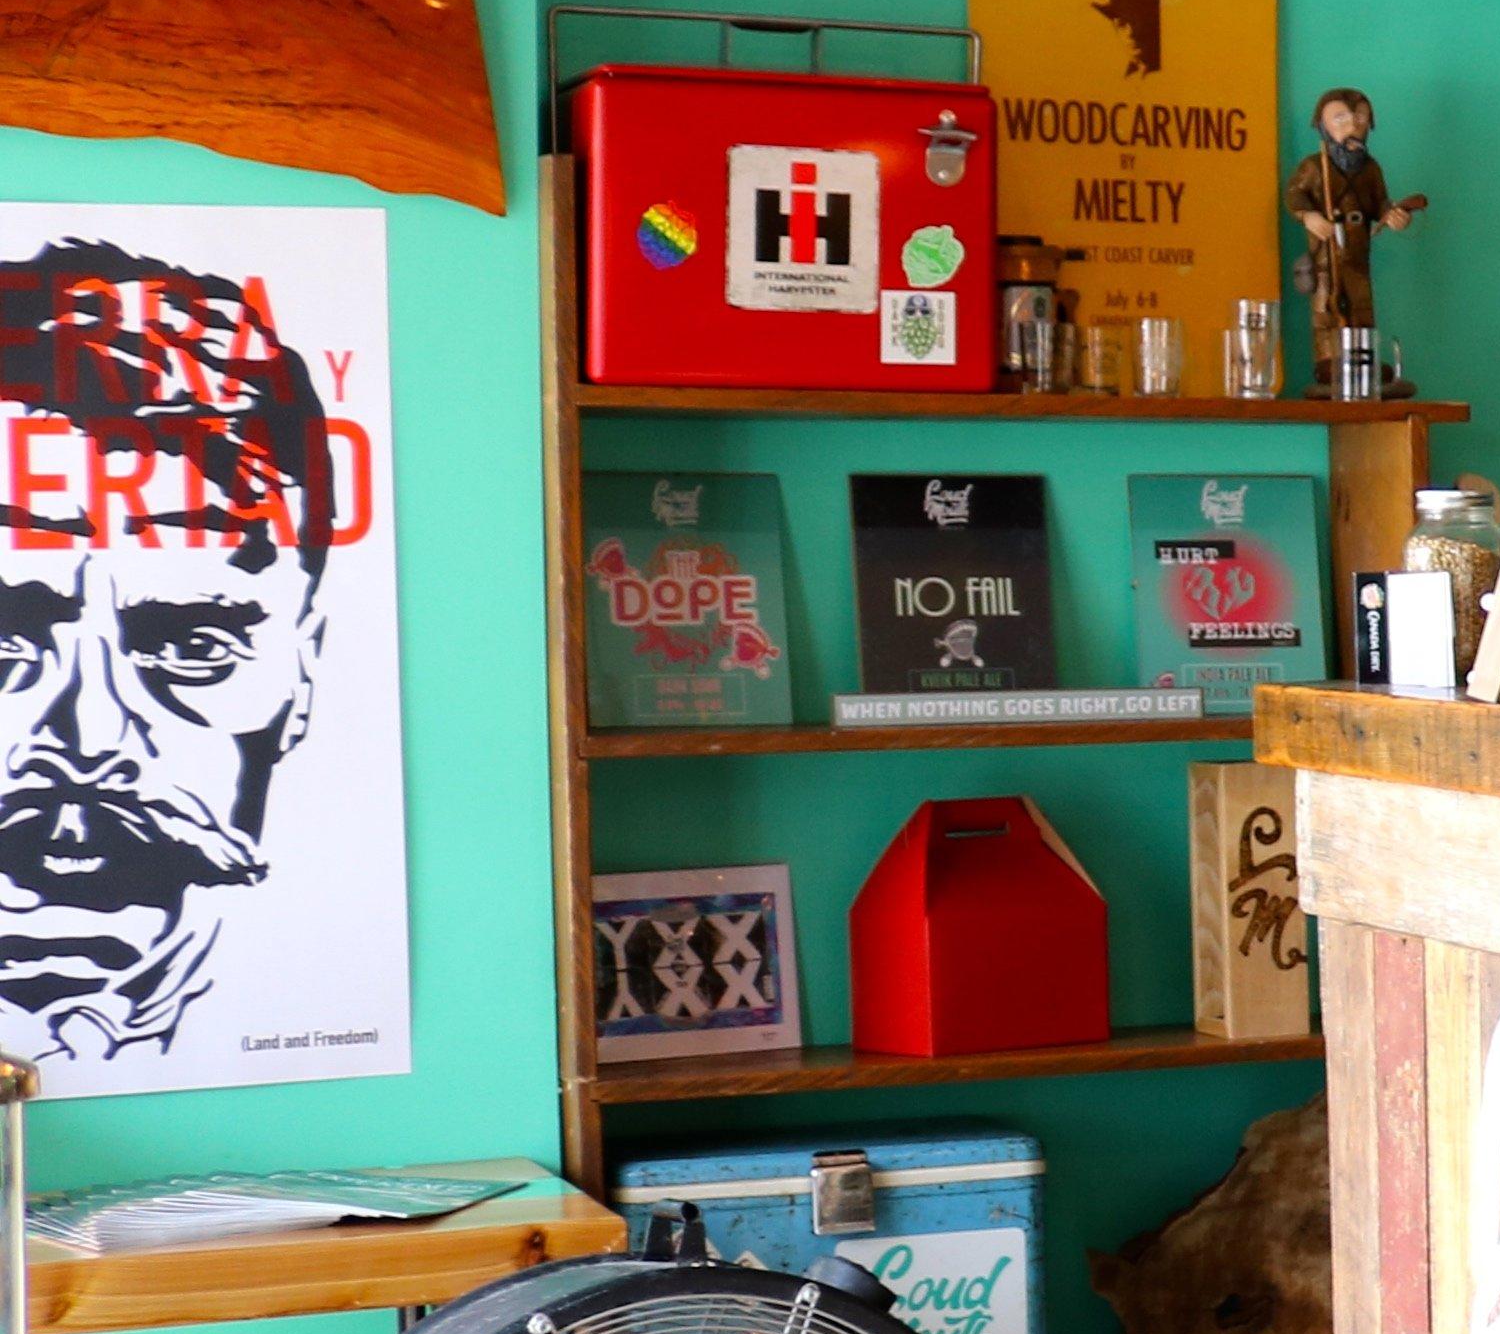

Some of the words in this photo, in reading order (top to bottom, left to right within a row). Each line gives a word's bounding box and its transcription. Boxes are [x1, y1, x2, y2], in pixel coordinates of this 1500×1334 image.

[1003, 98, 1248, 151] WOODCARVING
[1072, 178, 1185, 223] MIELTY
[1105, 245, 1143, 264] COAST
[1149, 246, 1195, 265] CARVER
[754, 271, 850, 284] INTERNATIONAL
[768, 283, 837, 296] HARVESTER
[323, 350, 354, 403] Y
[1159, 547, 1219, 565] HURT
[612, 576, 758, 625] DOPE
[895, 577, 956, 617] NO
[964, 577, 1021, 616] FAIL
[1190, 622, 1296, 641] FEELINGS
[1366, 611, 1380, 652] CANADA
[840, 701, 901, 719] WHEN
[907, 698, 999, 718] NOTHING
[1004, 697, 1055, 716] GOES
[1157, 694, 1200, 712] LEFT
[241, 1034, 281, 1053] (Land
[284, 1032, 311, 1049] and
[314, 1028, 380, 1047] Freedom)
